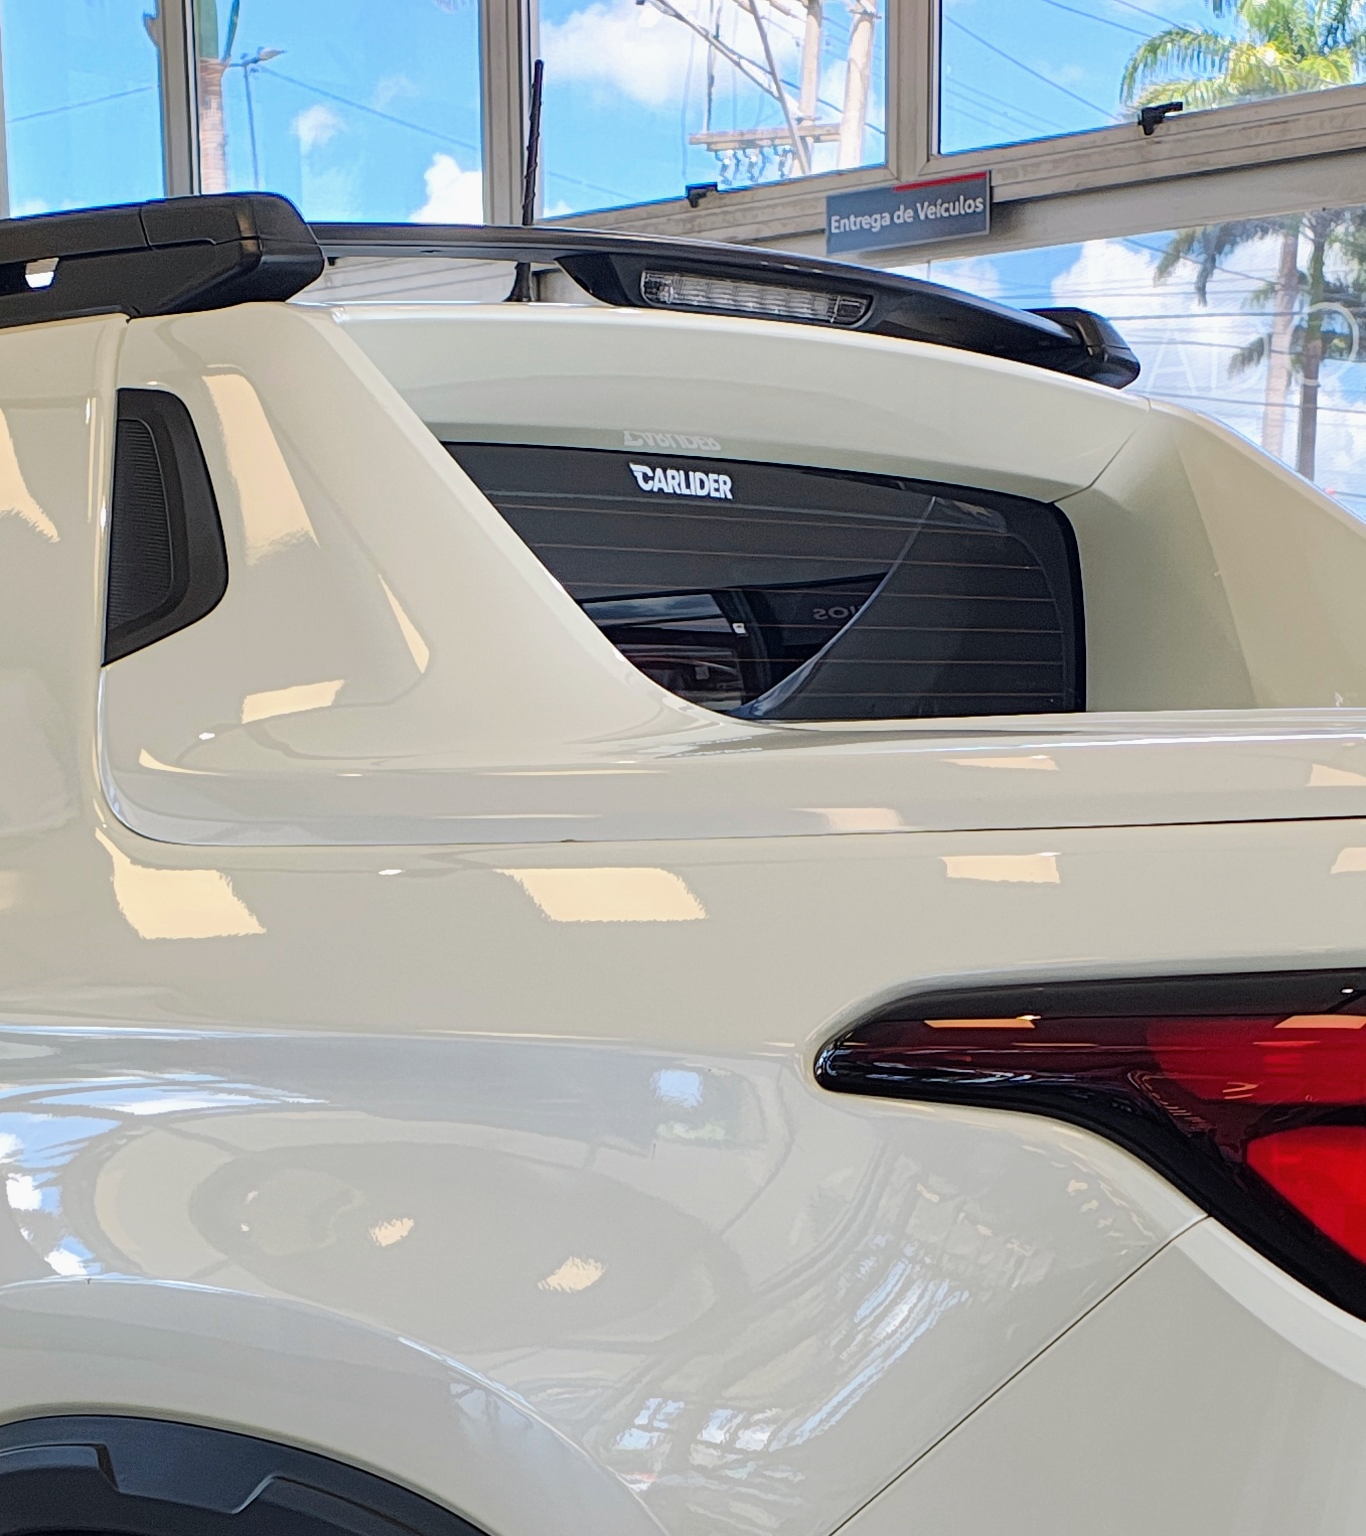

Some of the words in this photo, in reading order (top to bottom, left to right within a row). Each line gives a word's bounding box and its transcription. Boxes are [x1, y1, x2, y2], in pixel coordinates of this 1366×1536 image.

[830, 211, 891, 233] Entrega
[893, 204, 914, 224] de
[916, 195, 984, 220] Veículos
[629, 462, 733, 500] CARLIDER
